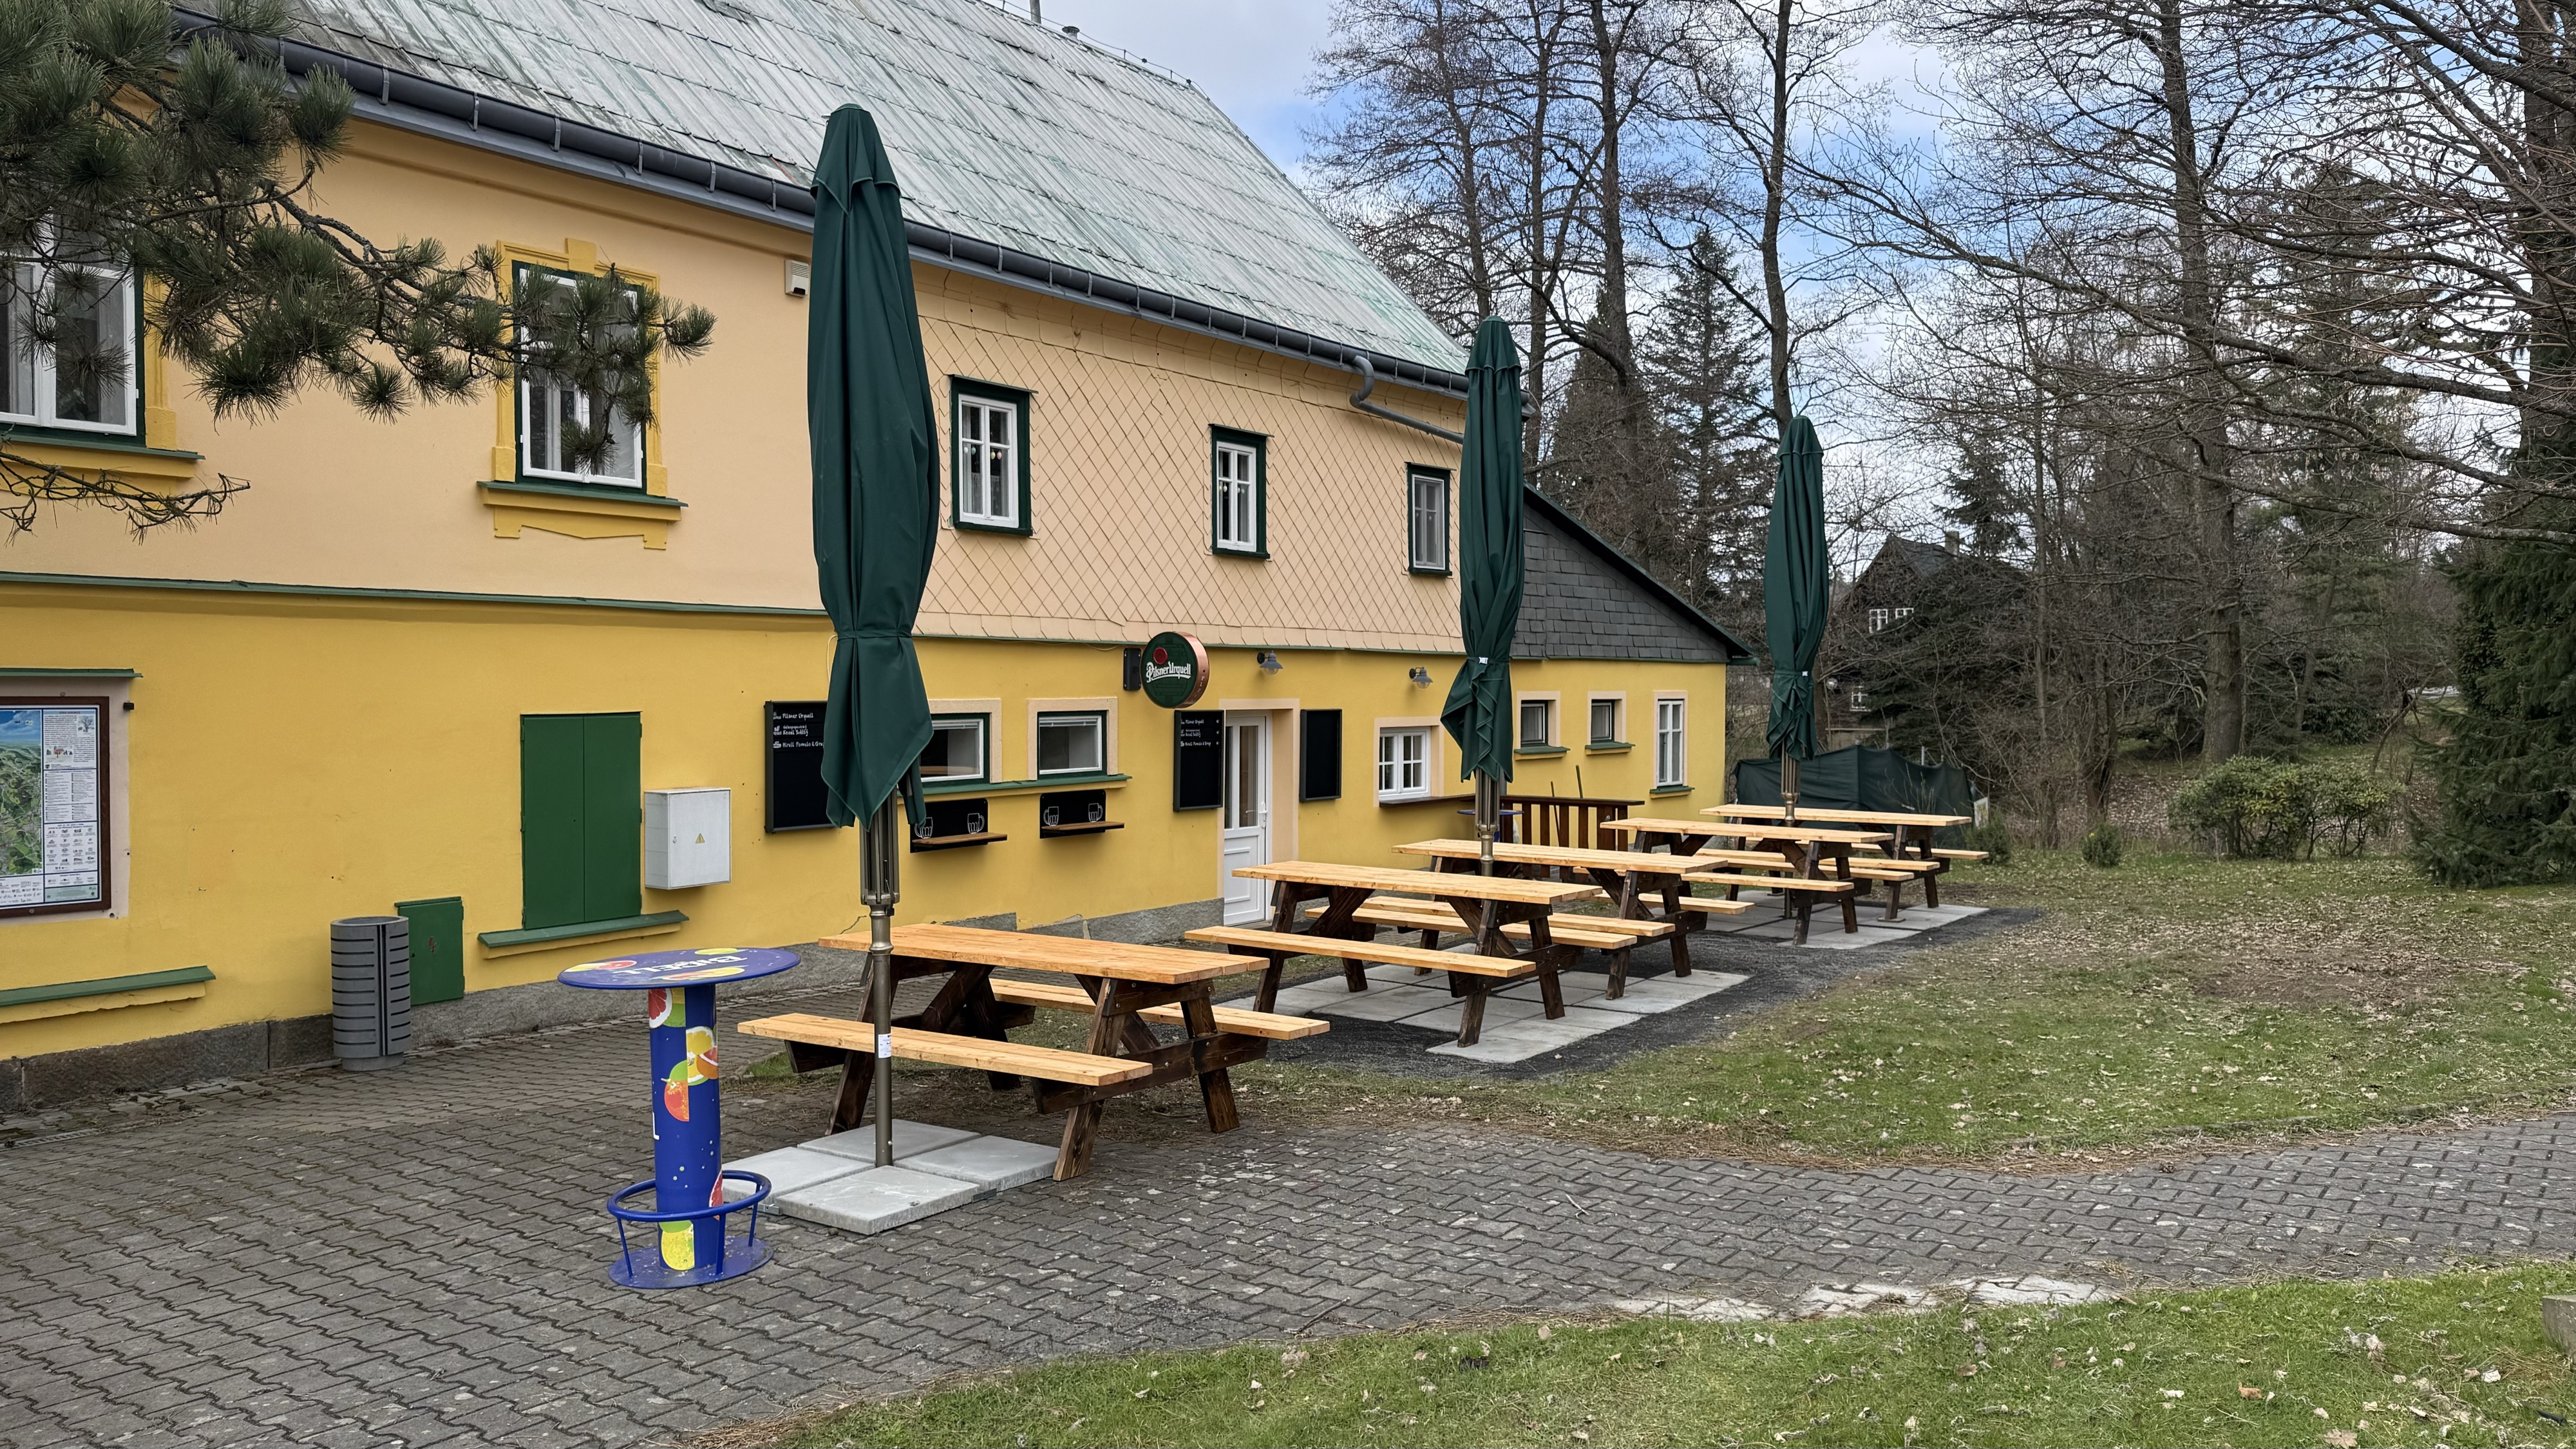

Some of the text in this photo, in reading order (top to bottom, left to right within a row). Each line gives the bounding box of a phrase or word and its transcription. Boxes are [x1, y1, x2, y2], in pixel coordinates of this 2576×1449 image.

[1146, 661, 1191, 683] Pilsner Urquell
[798, 712, 813, 721] Urquell
[815, 741, 824, 749] Gre
[613, 954, 748, 975] BIRELL
